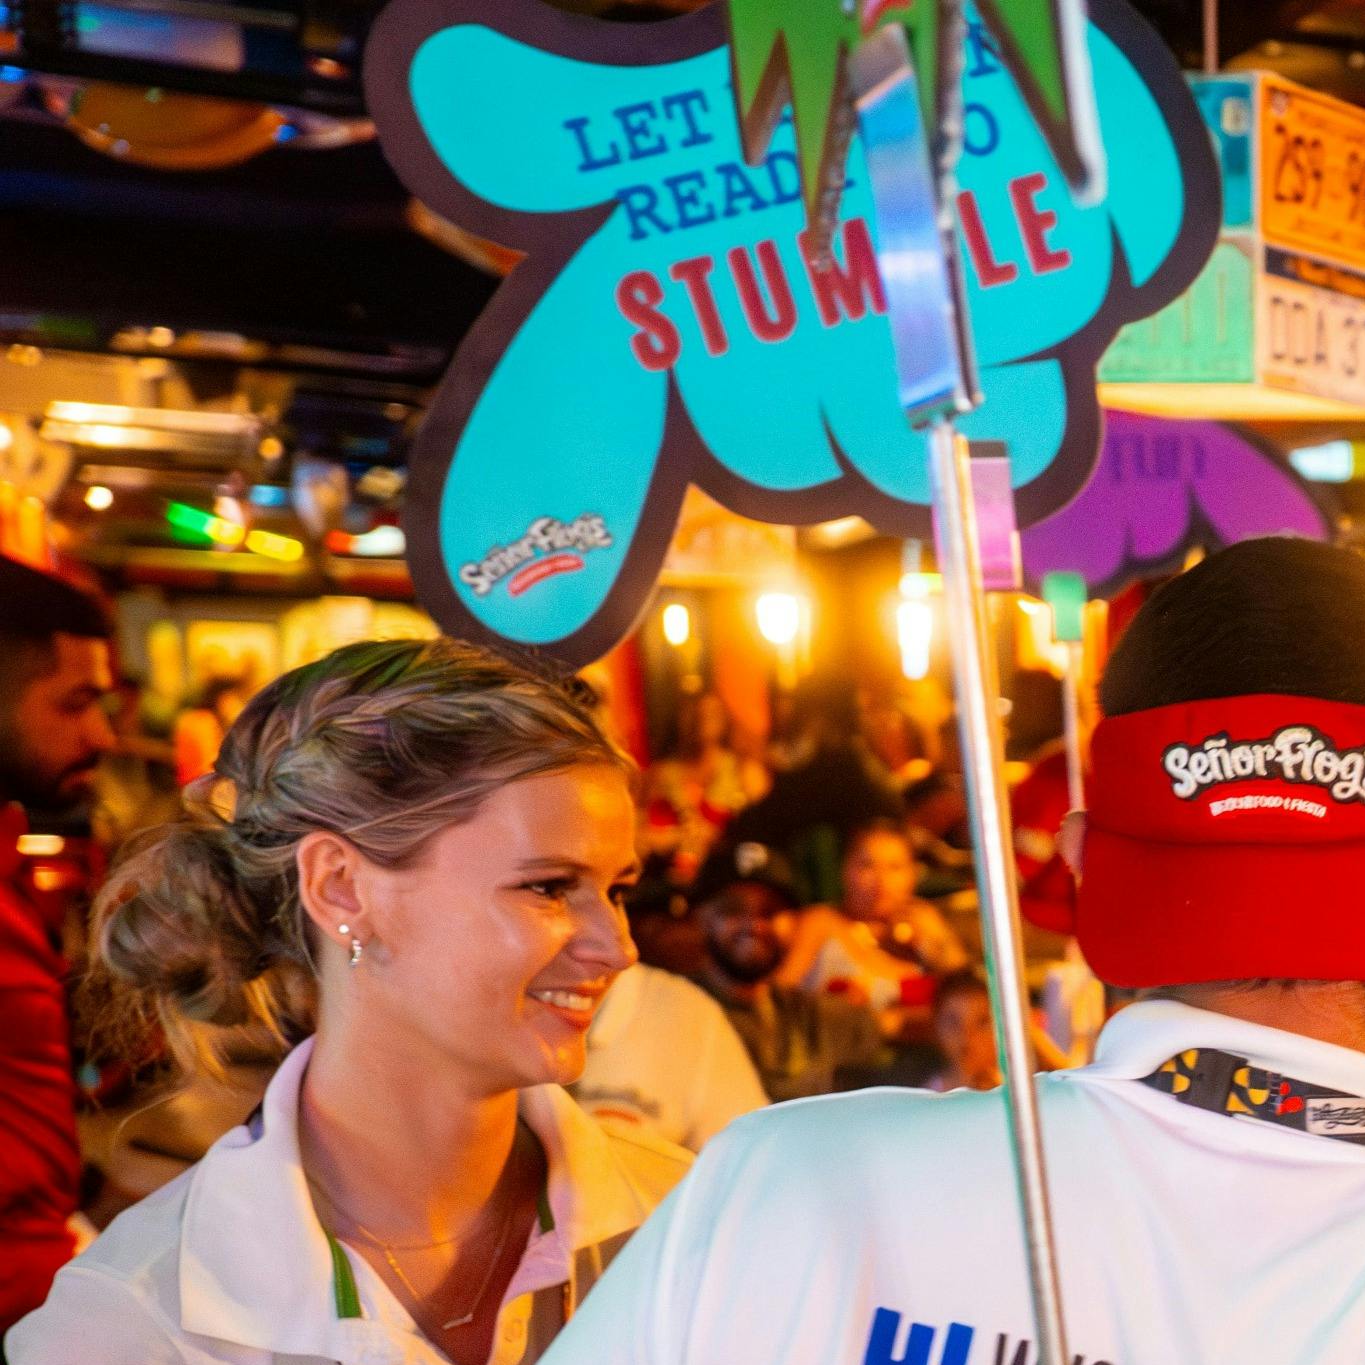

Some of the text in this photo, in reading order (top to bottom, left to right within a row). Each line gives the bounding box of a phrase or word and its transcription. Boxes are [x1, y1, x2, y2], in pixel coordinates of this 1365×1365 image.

[615, 150, 854, 242] READ
[614, 172, 1071, 371] STUMLE
[1164, 738, 1277, 798] Señor
